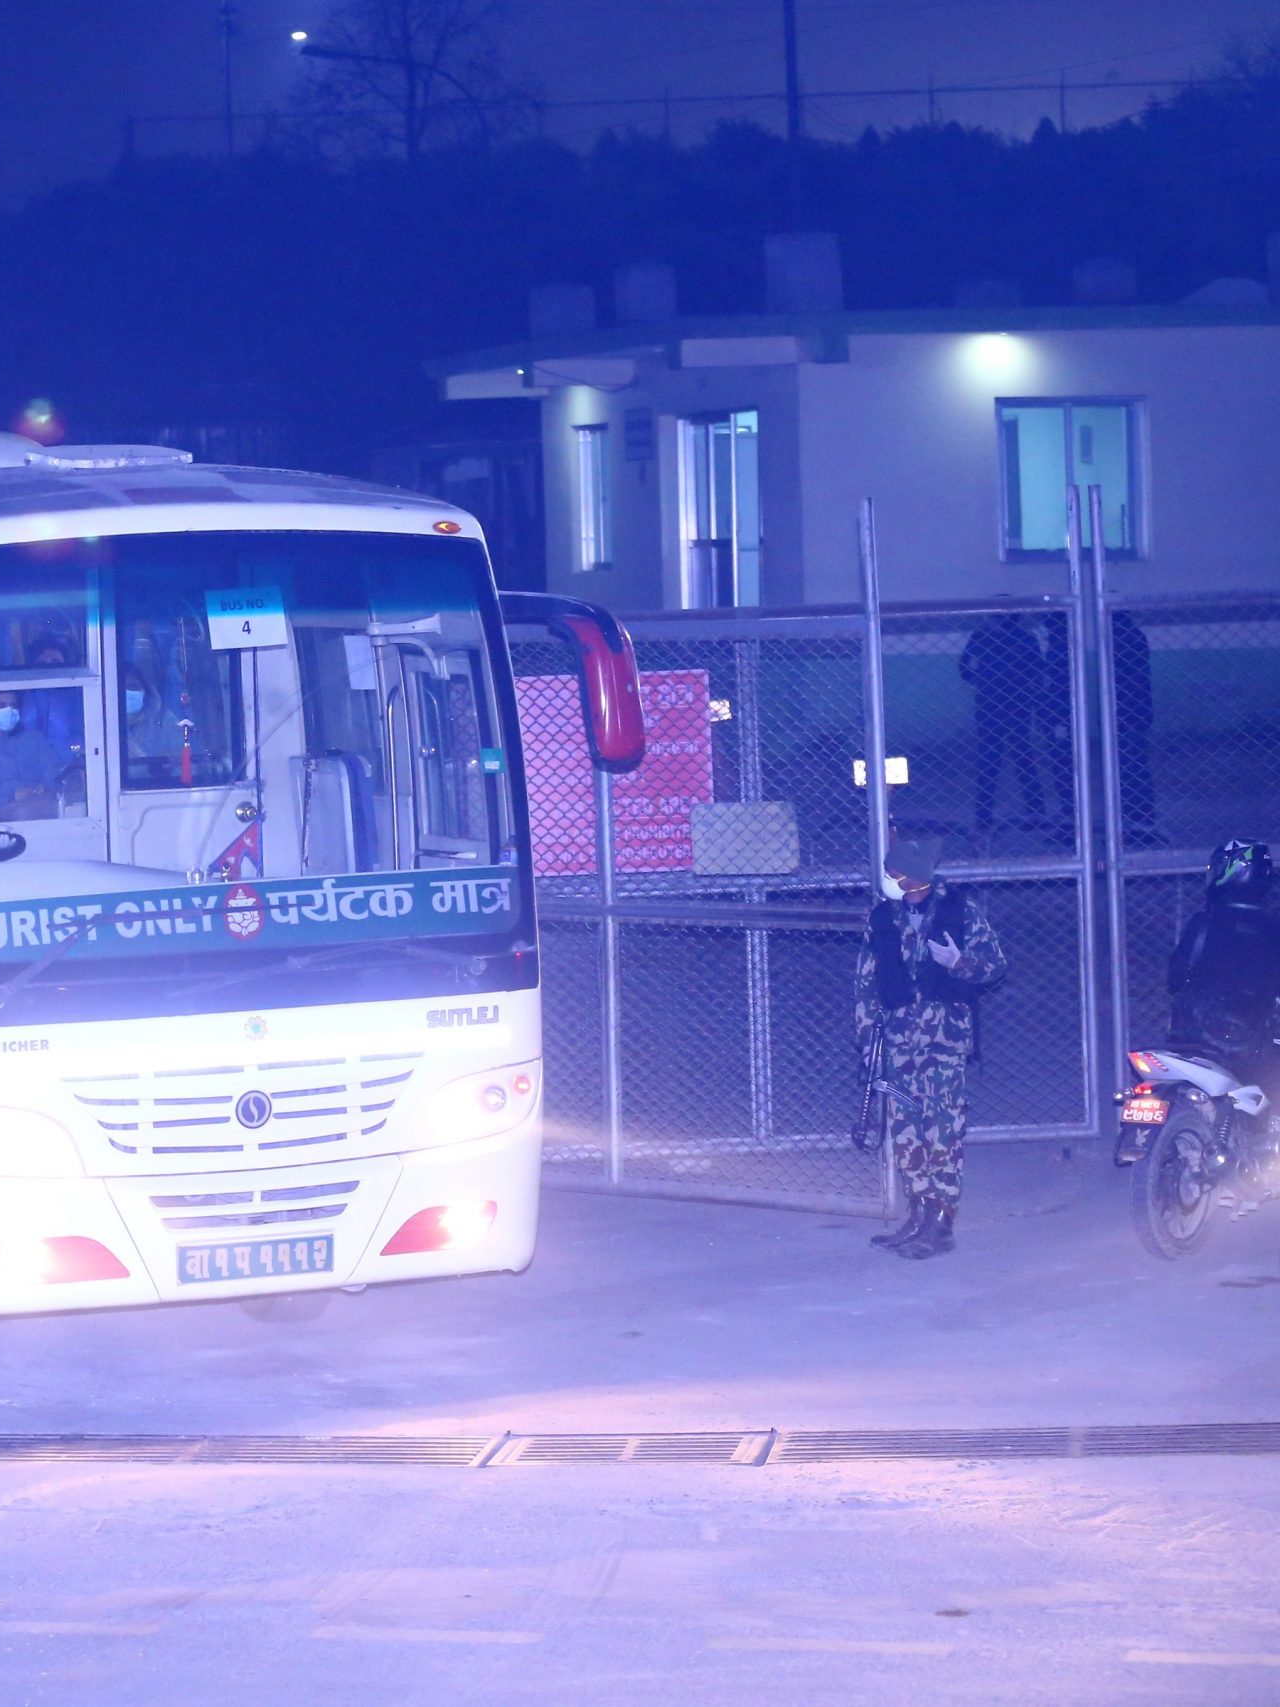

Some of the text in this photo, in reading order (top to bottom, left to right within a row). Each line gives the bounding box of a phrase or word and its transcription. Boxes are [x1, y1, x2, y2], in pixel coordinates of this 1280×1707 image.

[221, 600, 243, 612] BUS
[242, 620, 252, 635] 4
[429, 878, 511, 914] मात्र
[115, 895, 218, 938] ONLY
[426, 1005, 500, 1028] SUTLEJ
